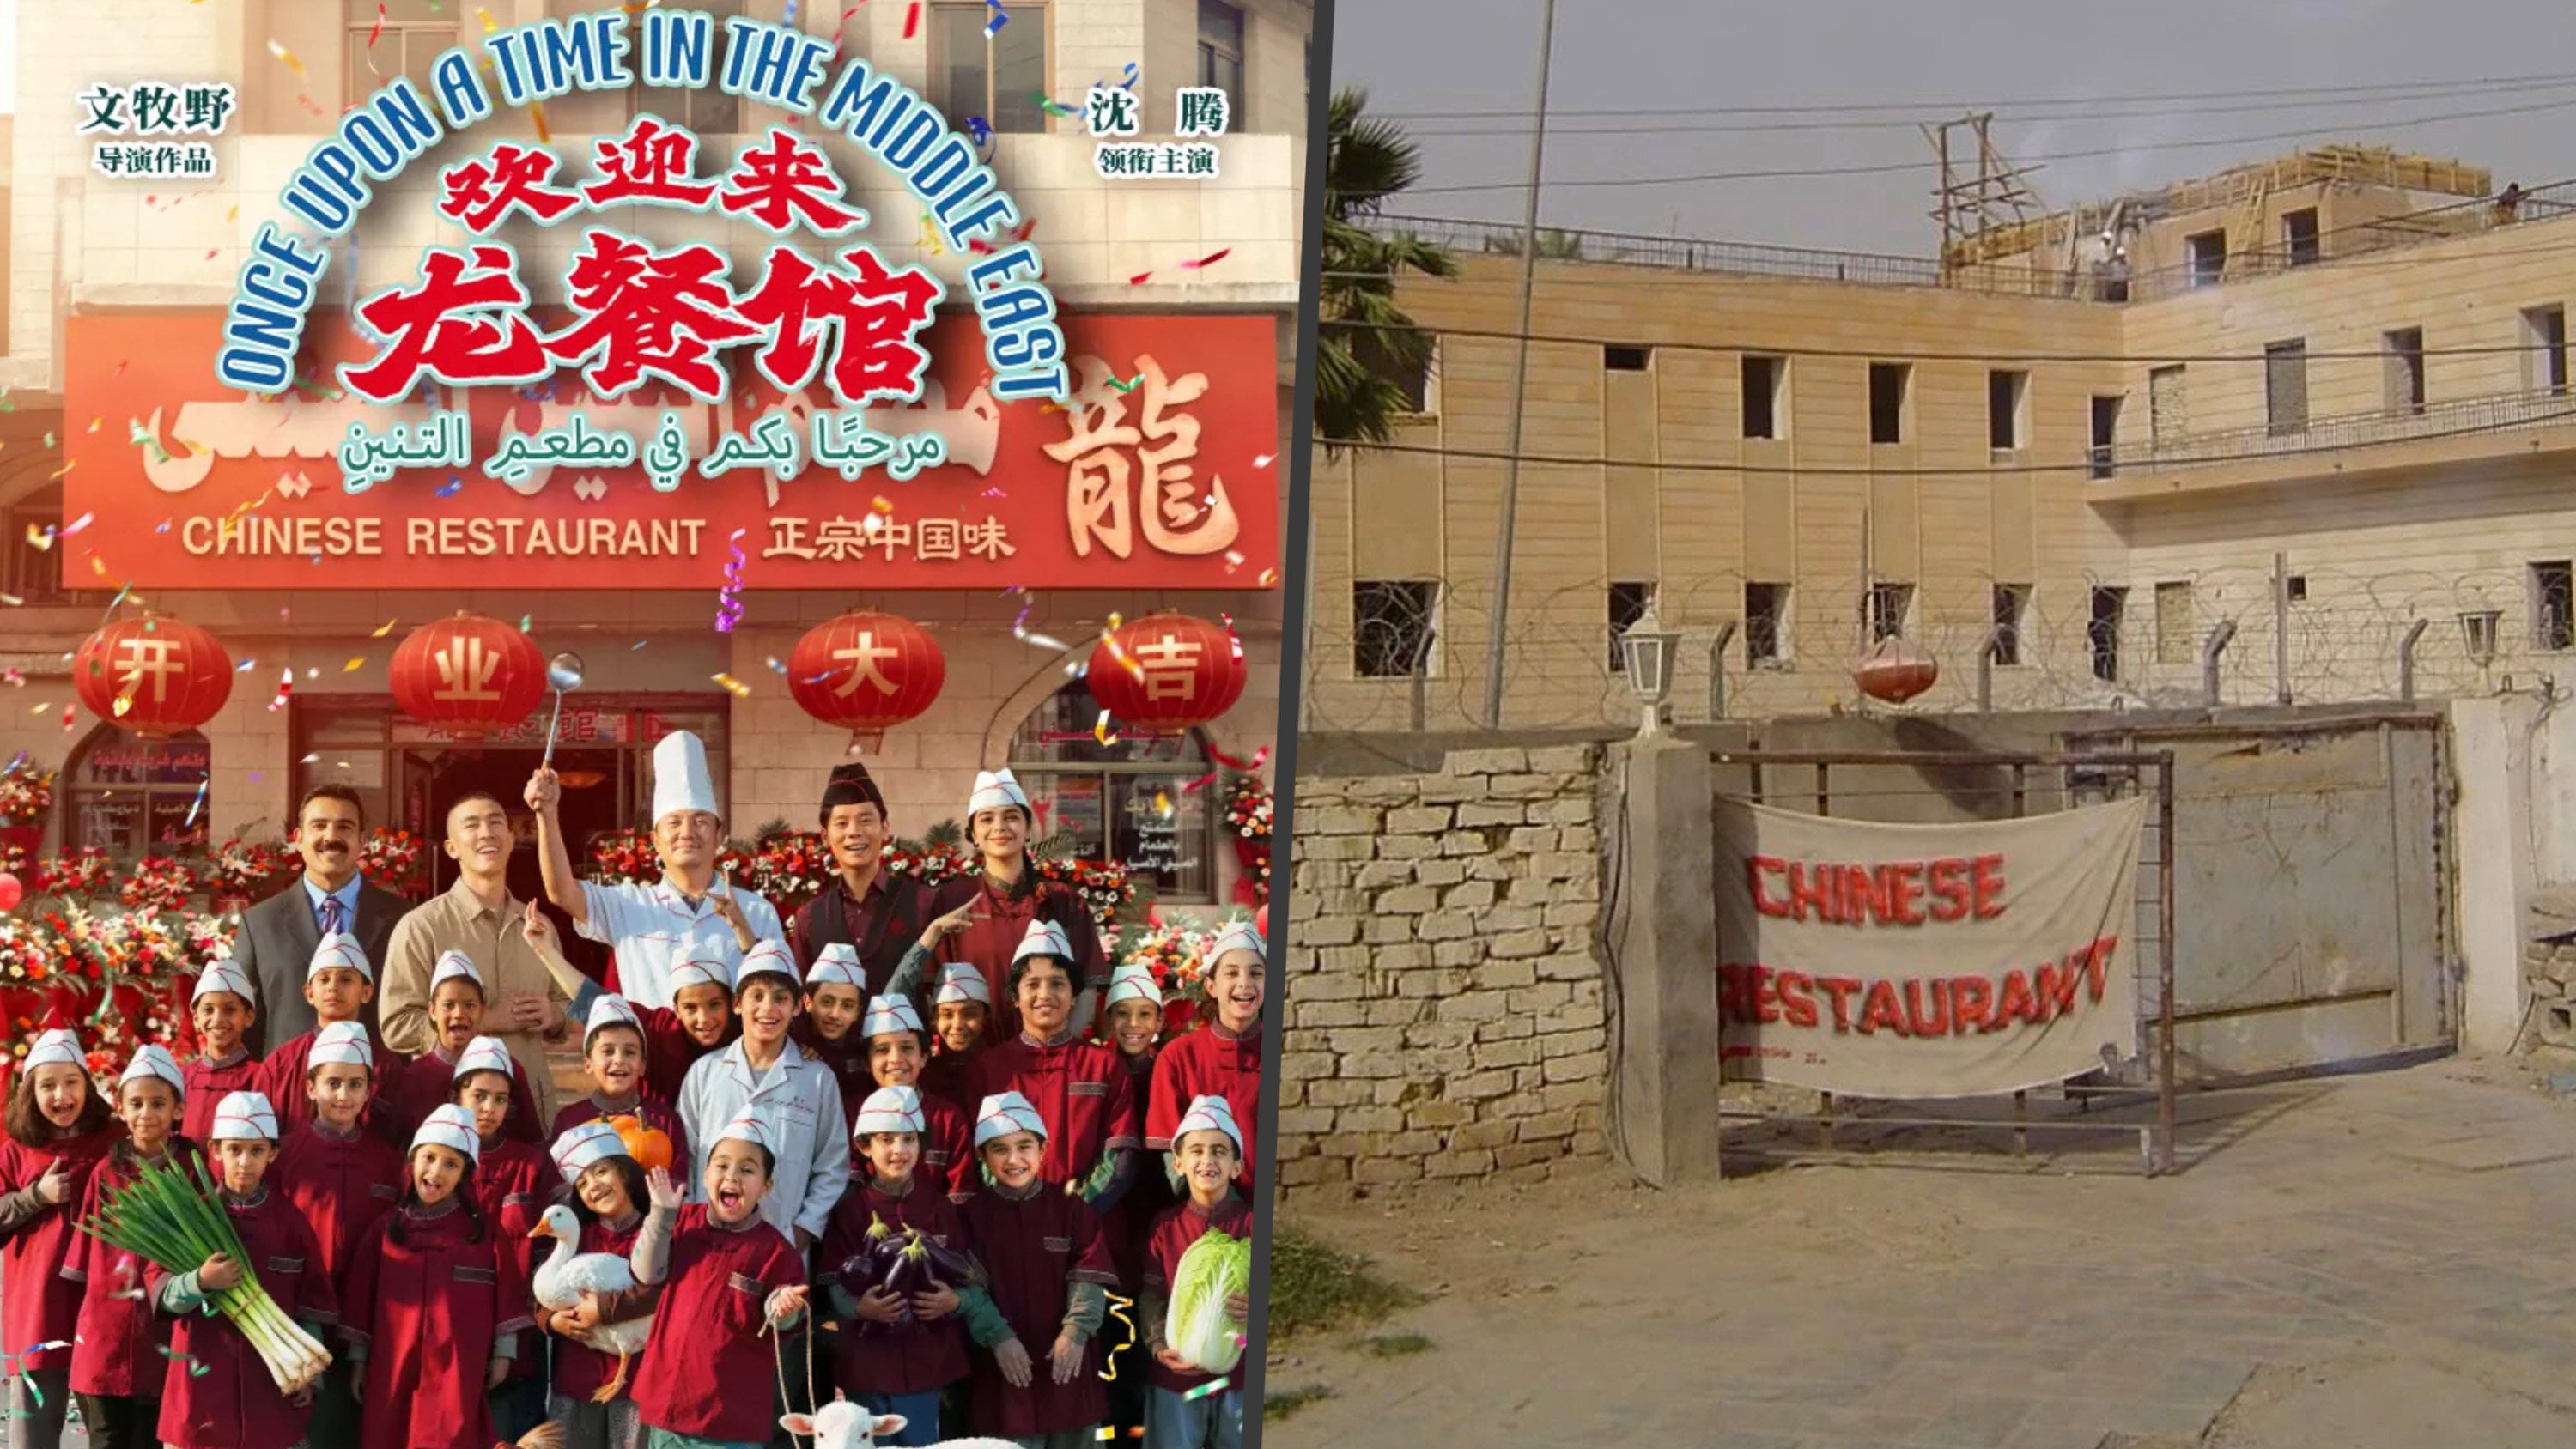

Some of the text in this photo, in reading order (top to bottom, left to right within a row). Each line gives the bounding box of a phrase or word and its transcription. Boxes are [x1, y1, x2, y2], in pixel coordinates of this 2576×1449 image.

[1041, 354, 1239, 559] 龍
[182, 516, 706, 555] CHINESE RESTAURANT
[762, 515, 1016, 560] 正宗中国味
[113, 631, 1201, 704] 开 业 大 吉
[1748, 853, 2008, 927] CHINESE
[1718, 935, 2118, 1039] RESTAURANT
